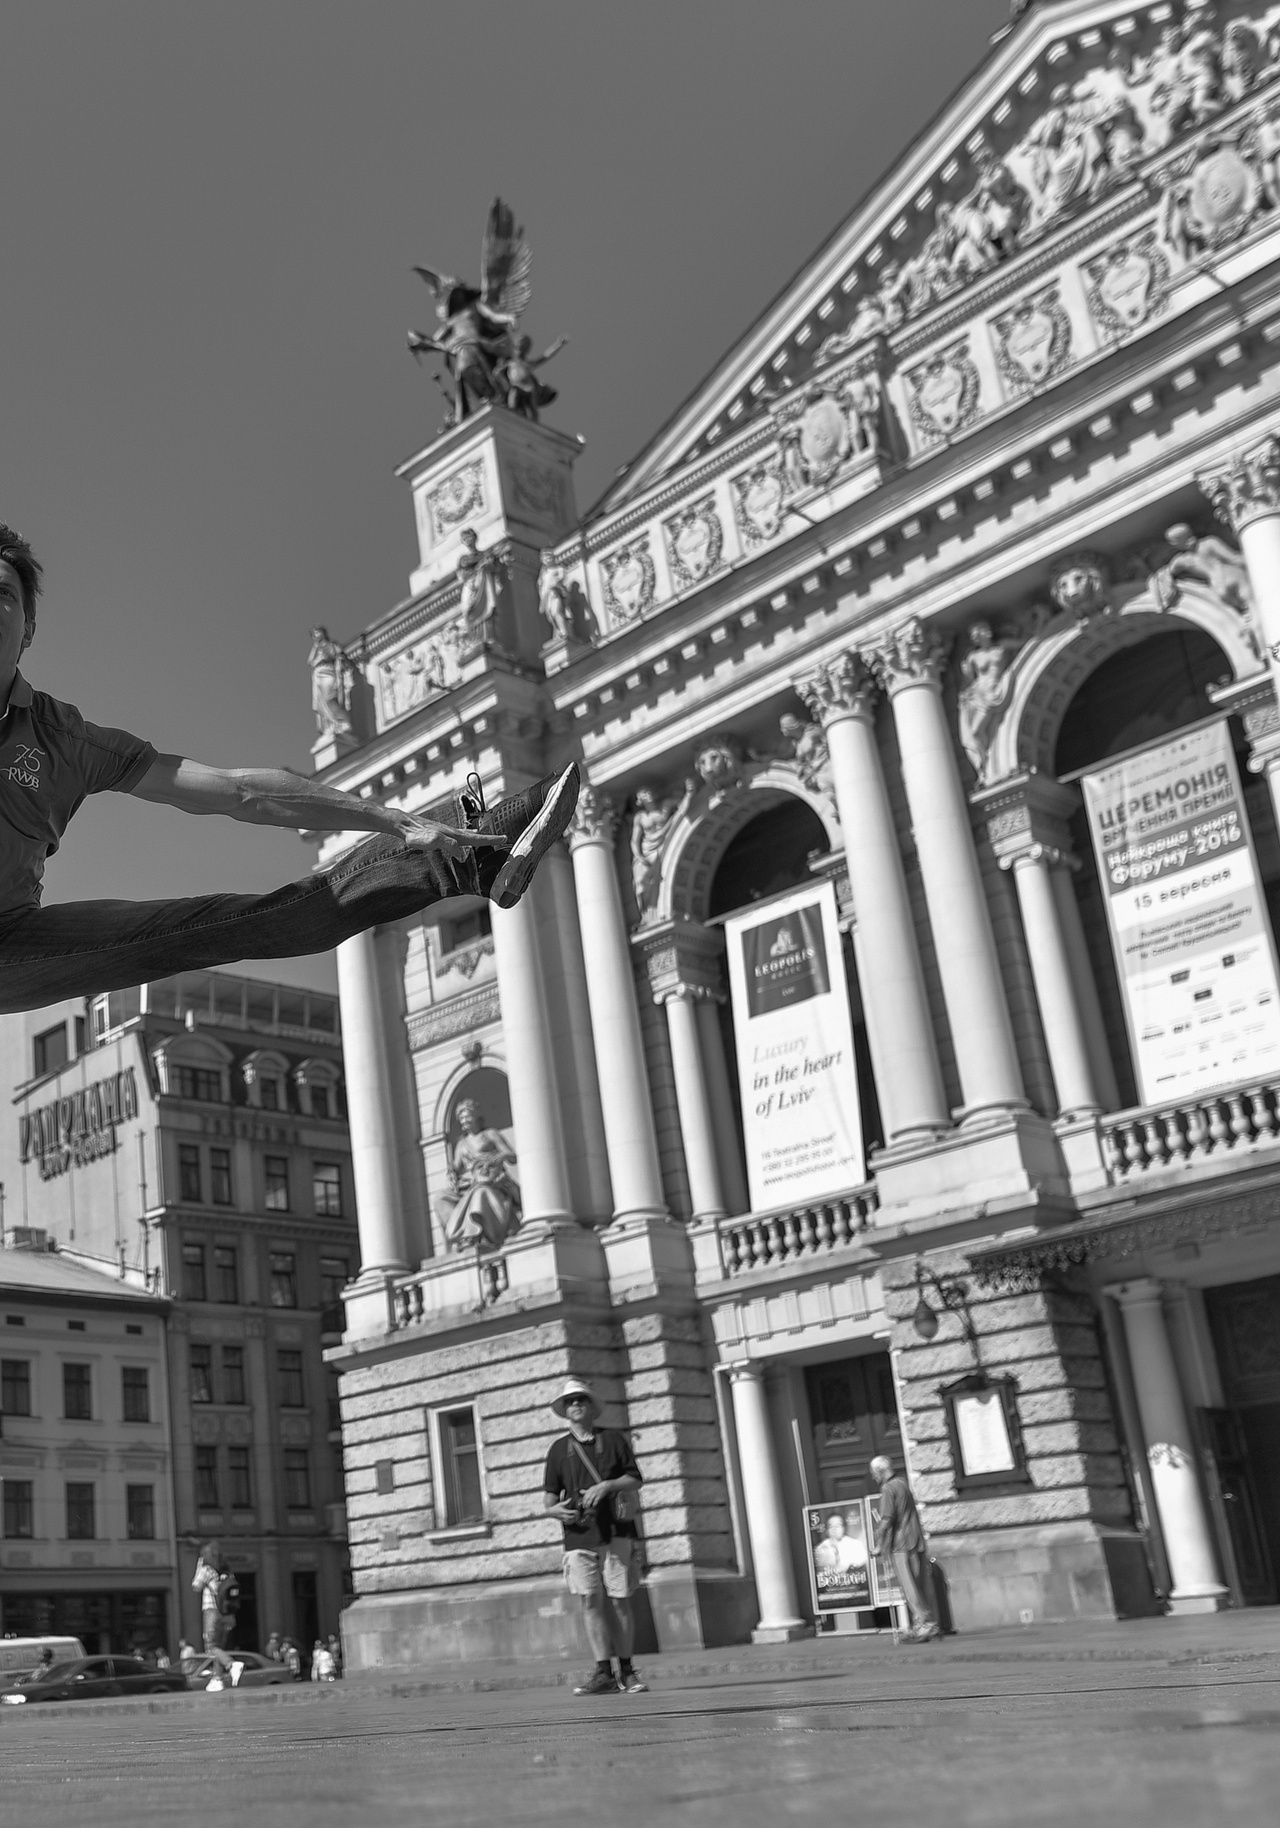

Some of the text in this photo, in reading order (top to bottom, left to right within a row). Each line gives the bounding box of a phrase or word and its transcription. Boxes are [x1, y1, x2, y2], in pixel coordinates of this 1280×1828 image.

[13, 744, 46, 772] 75
[4, 767, 40, 789] RWB
[1098, 762, 1231, 830] ЦЕРЕМОНІЯ
[1102, 782, 1234, 847] ВРУЧЕННЯ ПРЕМІЇ
[1107, 810, 1238, 869] Найкраща книга
[1134, 867, 1231, 909] 15 вересня
[754, 947, 815, 977] LEOPOLIS
[753, 1033, 809, 1064] Luxury
[753, 1050, 844, 1092] in the heart
[755, 1084, 816, 1119] of Lviv
